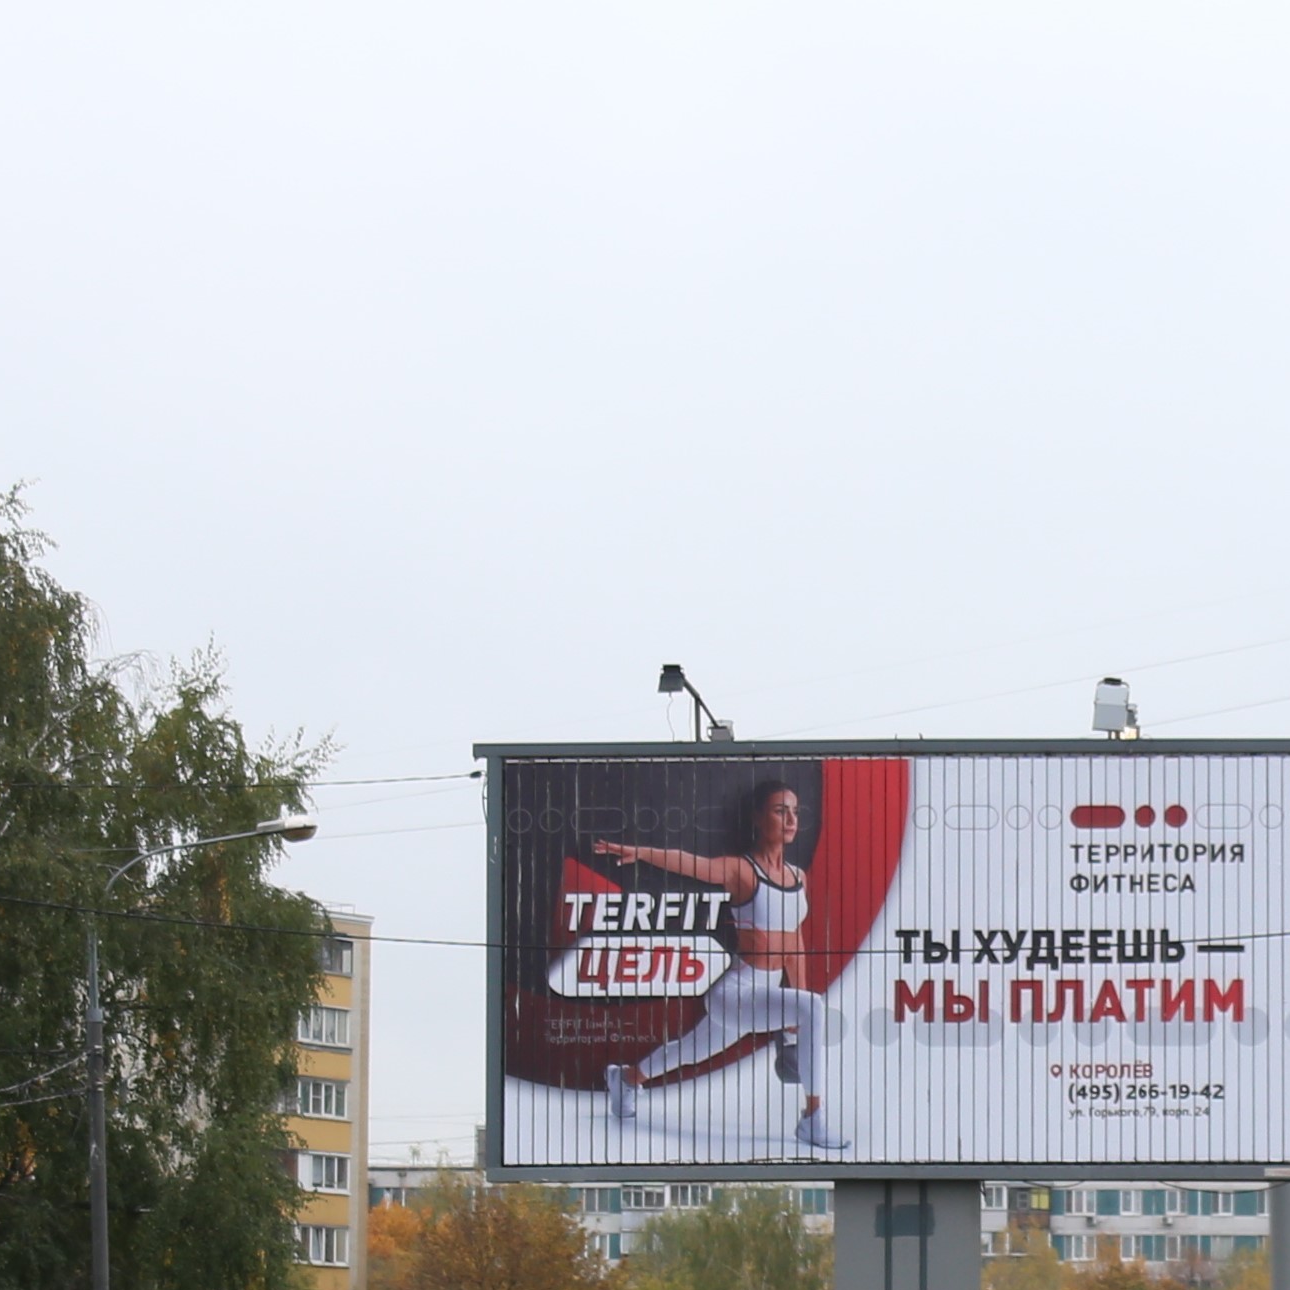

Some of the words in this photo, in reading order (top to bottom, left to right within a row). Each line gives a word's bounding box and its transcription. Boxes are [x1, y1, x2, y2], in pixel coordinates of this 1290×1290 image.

[1070, 843, 1245, 864] ТЕРРИТОРИЯ
[1070, 873, 1196, 894] ФИТНЕСА
[564, 892, 731, 932] TERFIT
[895, 929, 960, 964] ТЫ
[973, 929, 1186, 971] ХУДЕЕШЬ
[578, 945, 705, 990] ЦЕЛЬ
[894, 979, 989, 1024] МЫ
[1010, 978, 1244, 1024] ПЛАТИМ
[1069, 1060, 1153, 1079] КОРОЛЁВ
[1068, 1083, 1120, 1104] (495)
[1125, 1083, 1225, 1100] 266-19-42
[1195, 1106, 1210, 1117] 24
